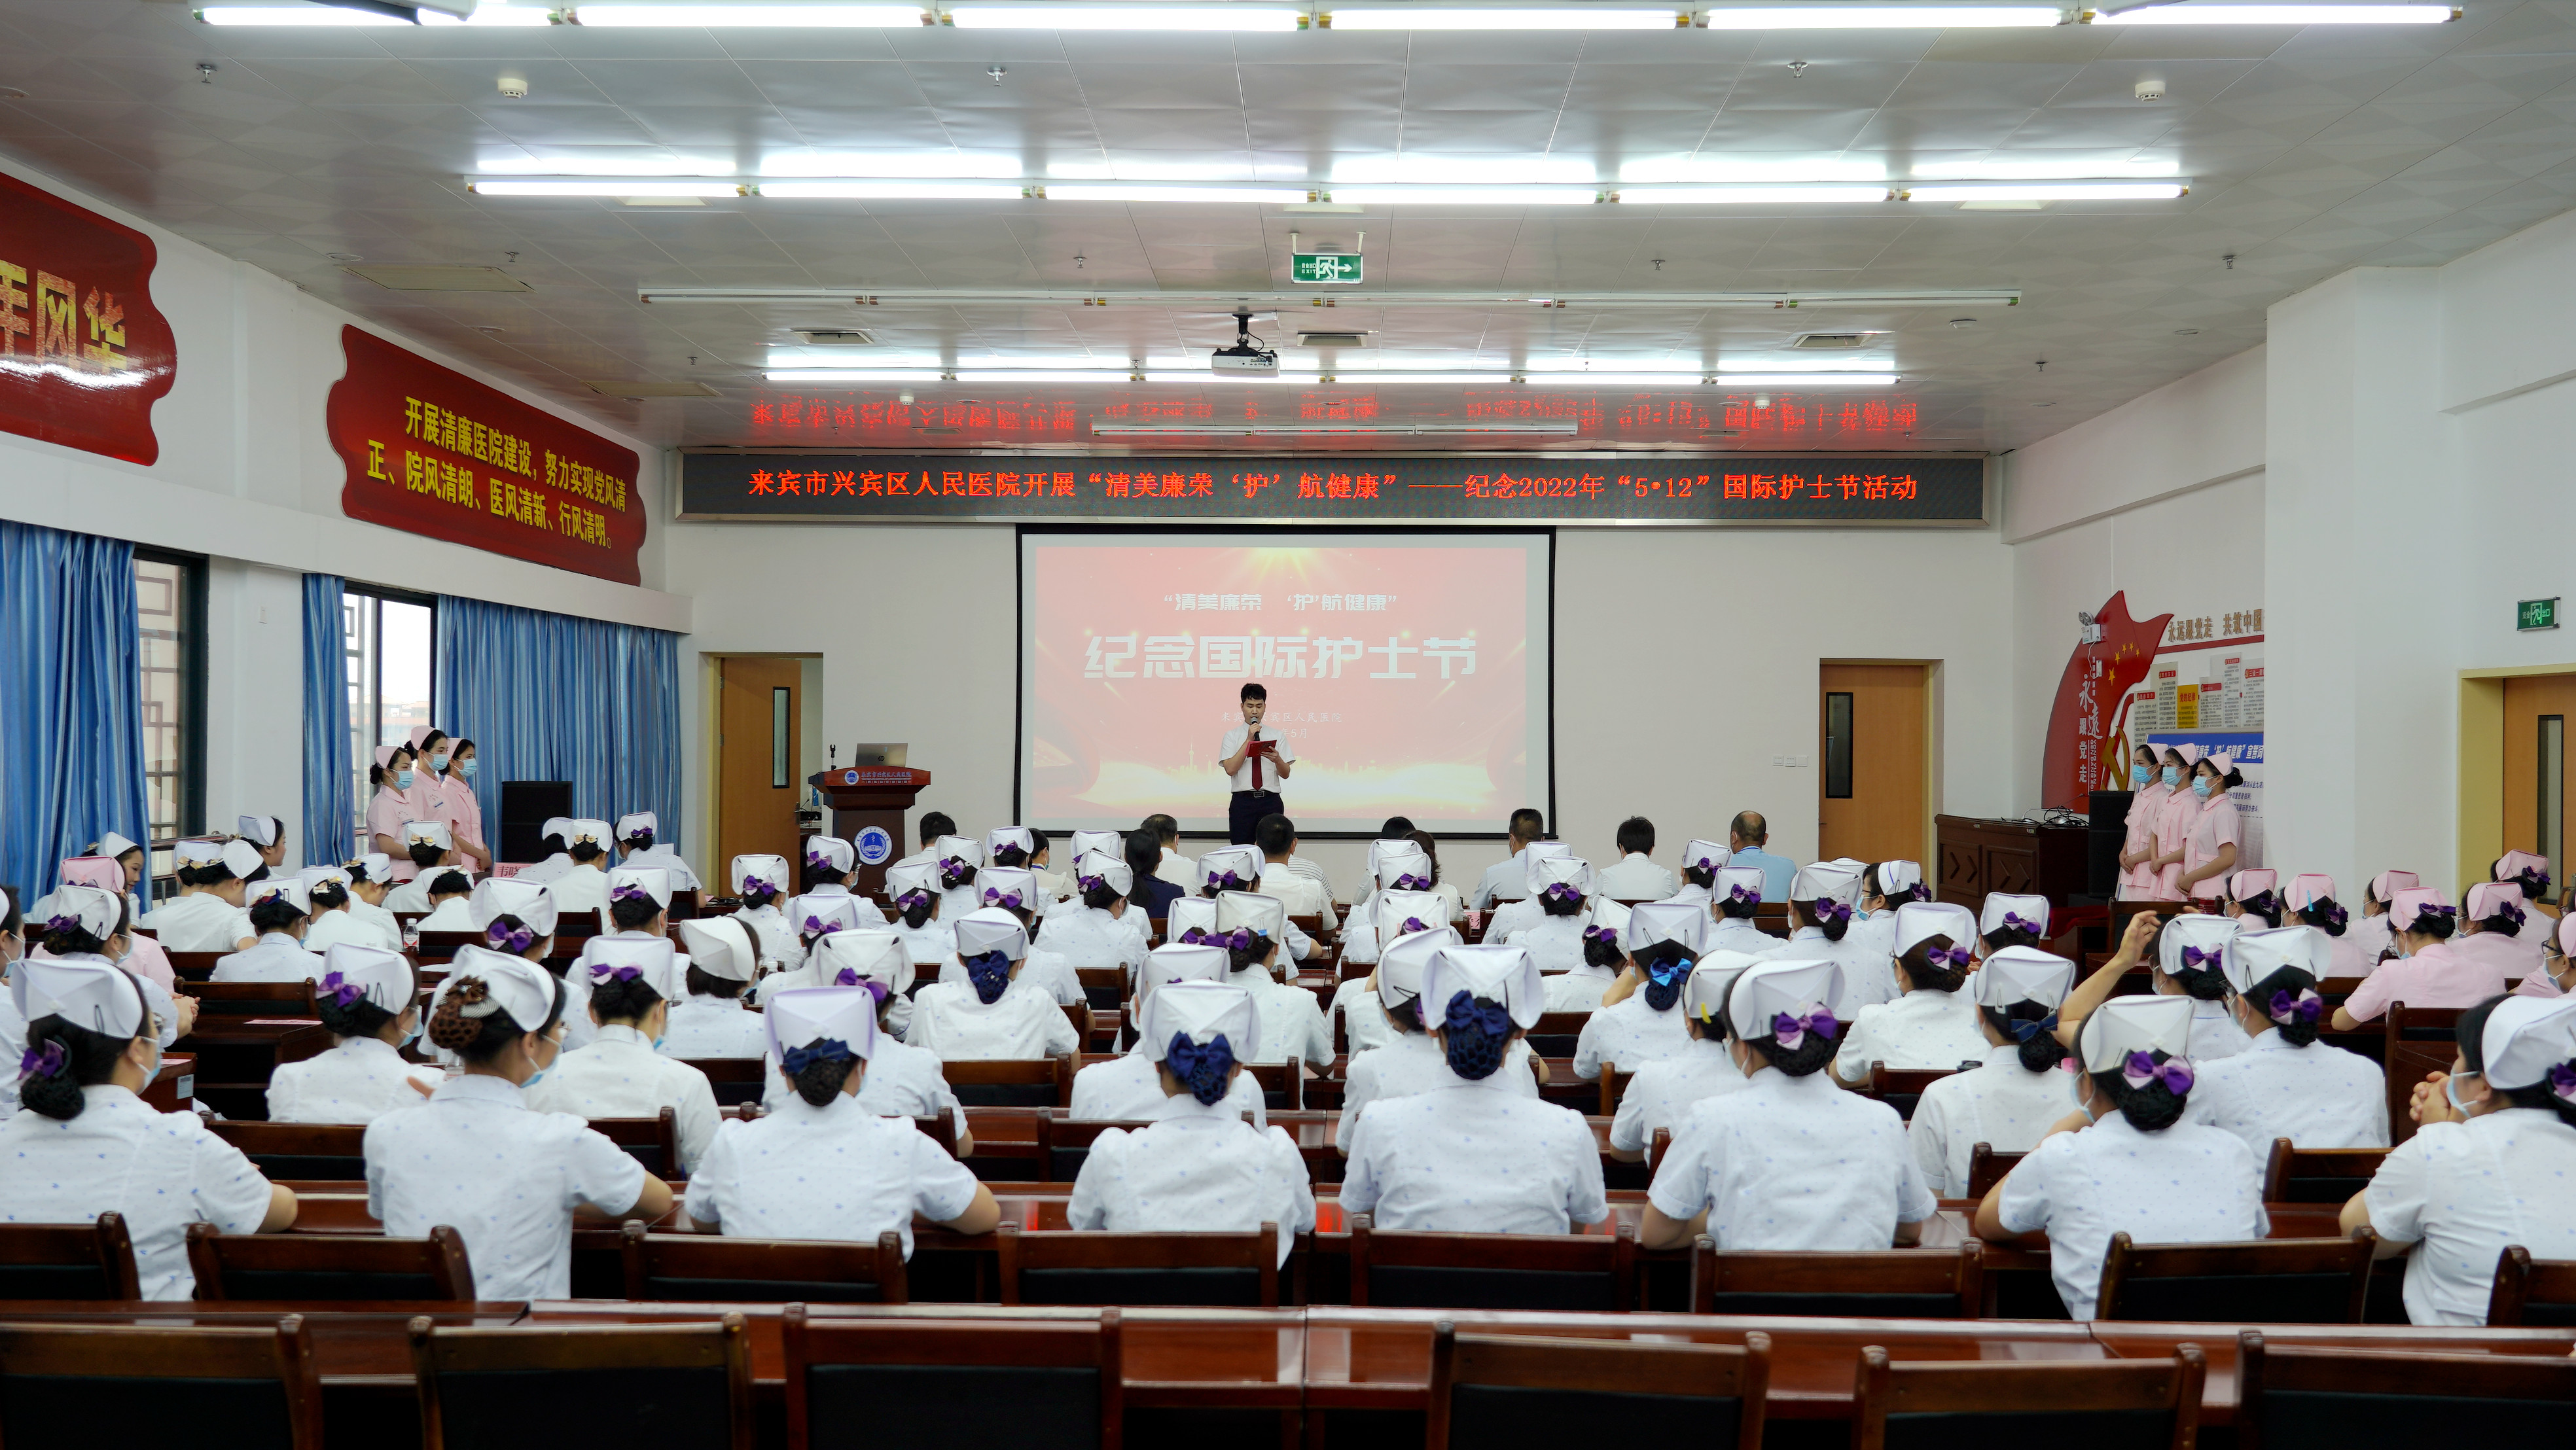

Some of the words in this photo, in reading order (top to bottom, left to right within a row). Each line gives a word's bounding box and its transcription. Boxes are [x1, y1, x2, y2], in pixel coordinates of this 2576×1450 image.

[2168, 616, 2213, 643] 永远跟党走
[1084, 635, 1476, 679] 纪念国际护士节
[2079, 718, 2087, 783] 跟党走
